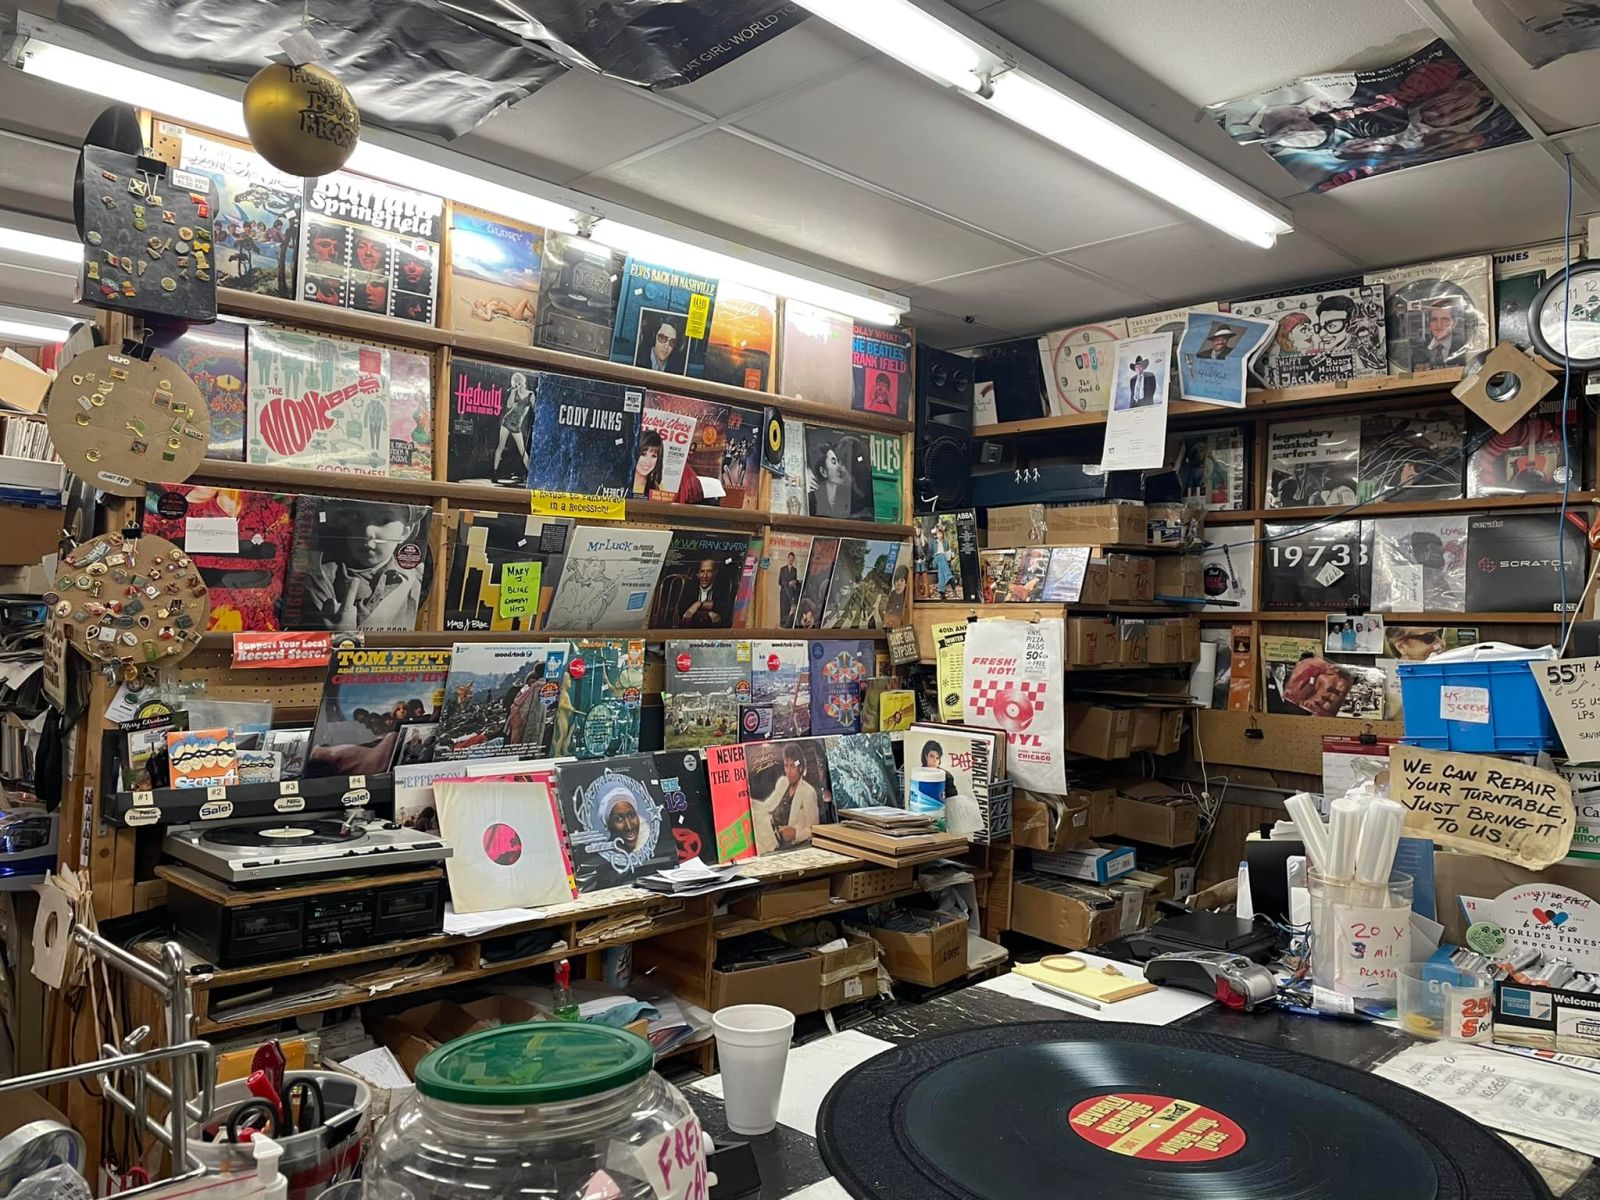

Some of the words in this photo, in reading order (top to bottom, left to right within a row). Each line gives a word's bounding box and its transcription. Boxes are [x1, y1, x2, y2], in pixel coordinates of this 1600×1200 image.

[310, 191, 433, 237] Springfield
[630, 263, 651, 281] ELVIS
[651, 268, 671, 286] BACK
[680, 276, 715, 297] NASHVILLE
[1585, 281, 1597, 292] 12
[1281, 371, 1315, 385] JACK
[267, 387, 283, 396] THE
[454, 373, 502, 416] Hedwig
[259, 377, 381, 456] MONKEES
[558, 404, 588, 427] CODY
[590, 408, 623, 432] JINKS
[1272, 428, 1334, 443] legendary
[1272, 438, 1318, 451] masked
[870, 434, 900, 474] ATLES
[1272, 449, 1317, 460] surfers
[605, 539, 633, 551] Luck
[699, 539, 722, 550] FRANK
[722, 541, 748, 551] SINATRA
[1269, 543, 1351, 568] 1973
[1499, 559, 1573, 569] SCRATCH
[507, 566, 530, 577] MARY
[507, 586, 529, 594] BLIGE
[510, 605, 526, 613] HITS
[938, 625, 953, 633] 40th
[237, 640, 277, 651] Support
[279, 640, 301, 648] Your
[302, 639, 327, 648] Local
[237, 649, 285, 661] Record
[287, 648, 327, 660] Store!
[337, 651, 387, 666] TOM
[390, 651, 452, 666] PETT
[971, 657, 1017, 666] FRESH!
[337, 665, 354, 674] and
[355, 665, 370, 673] the
[987, 667, 1017, 675] HOT!
[1546, 663, 1586, 685] 55TH
[1571, 699, 1586, 709] 55
[1577, 710, 1595, 720] LPs
[716, 747, 745, 765] NEVER
[971, 739, 990, 786] MICHAEL
[1017, 753, 1051, 762] CHICAGO
[351, 777, 361, 785] #4
[711, 769, 731, 785] THE
[734, 767, 746, 782] BO
[1402, 758, 1433, 776] WE
[1443, 764, 1479, 783] CAN
[1487, 770, 1556, 800] REPAIR
[211, 788, 222, 796] #2
[285, 783, 296, 791] #3
[138, 793, 148, 801] #1
[342, 792, 369, 805] Sale!
[1405, 776, 1451, 795] YOUR
[1462, 787, 1568, 826] TURNTABLE,
[201, 803, 232, 817] Sale!
[1402, 795, 1460, 816] JUST
[1466, 806, 1526, 830] BRING
[1536, 823, 1558, 837] IT
[1434, 816, 1460, 834] TO
[1350, 922, 1380, 939] 20
[1461, 1019, 1479, 1038] 5
[1072, 1095, 1132, 1127] BEVERLY
[658, 1119, 700, 1192] FRE
